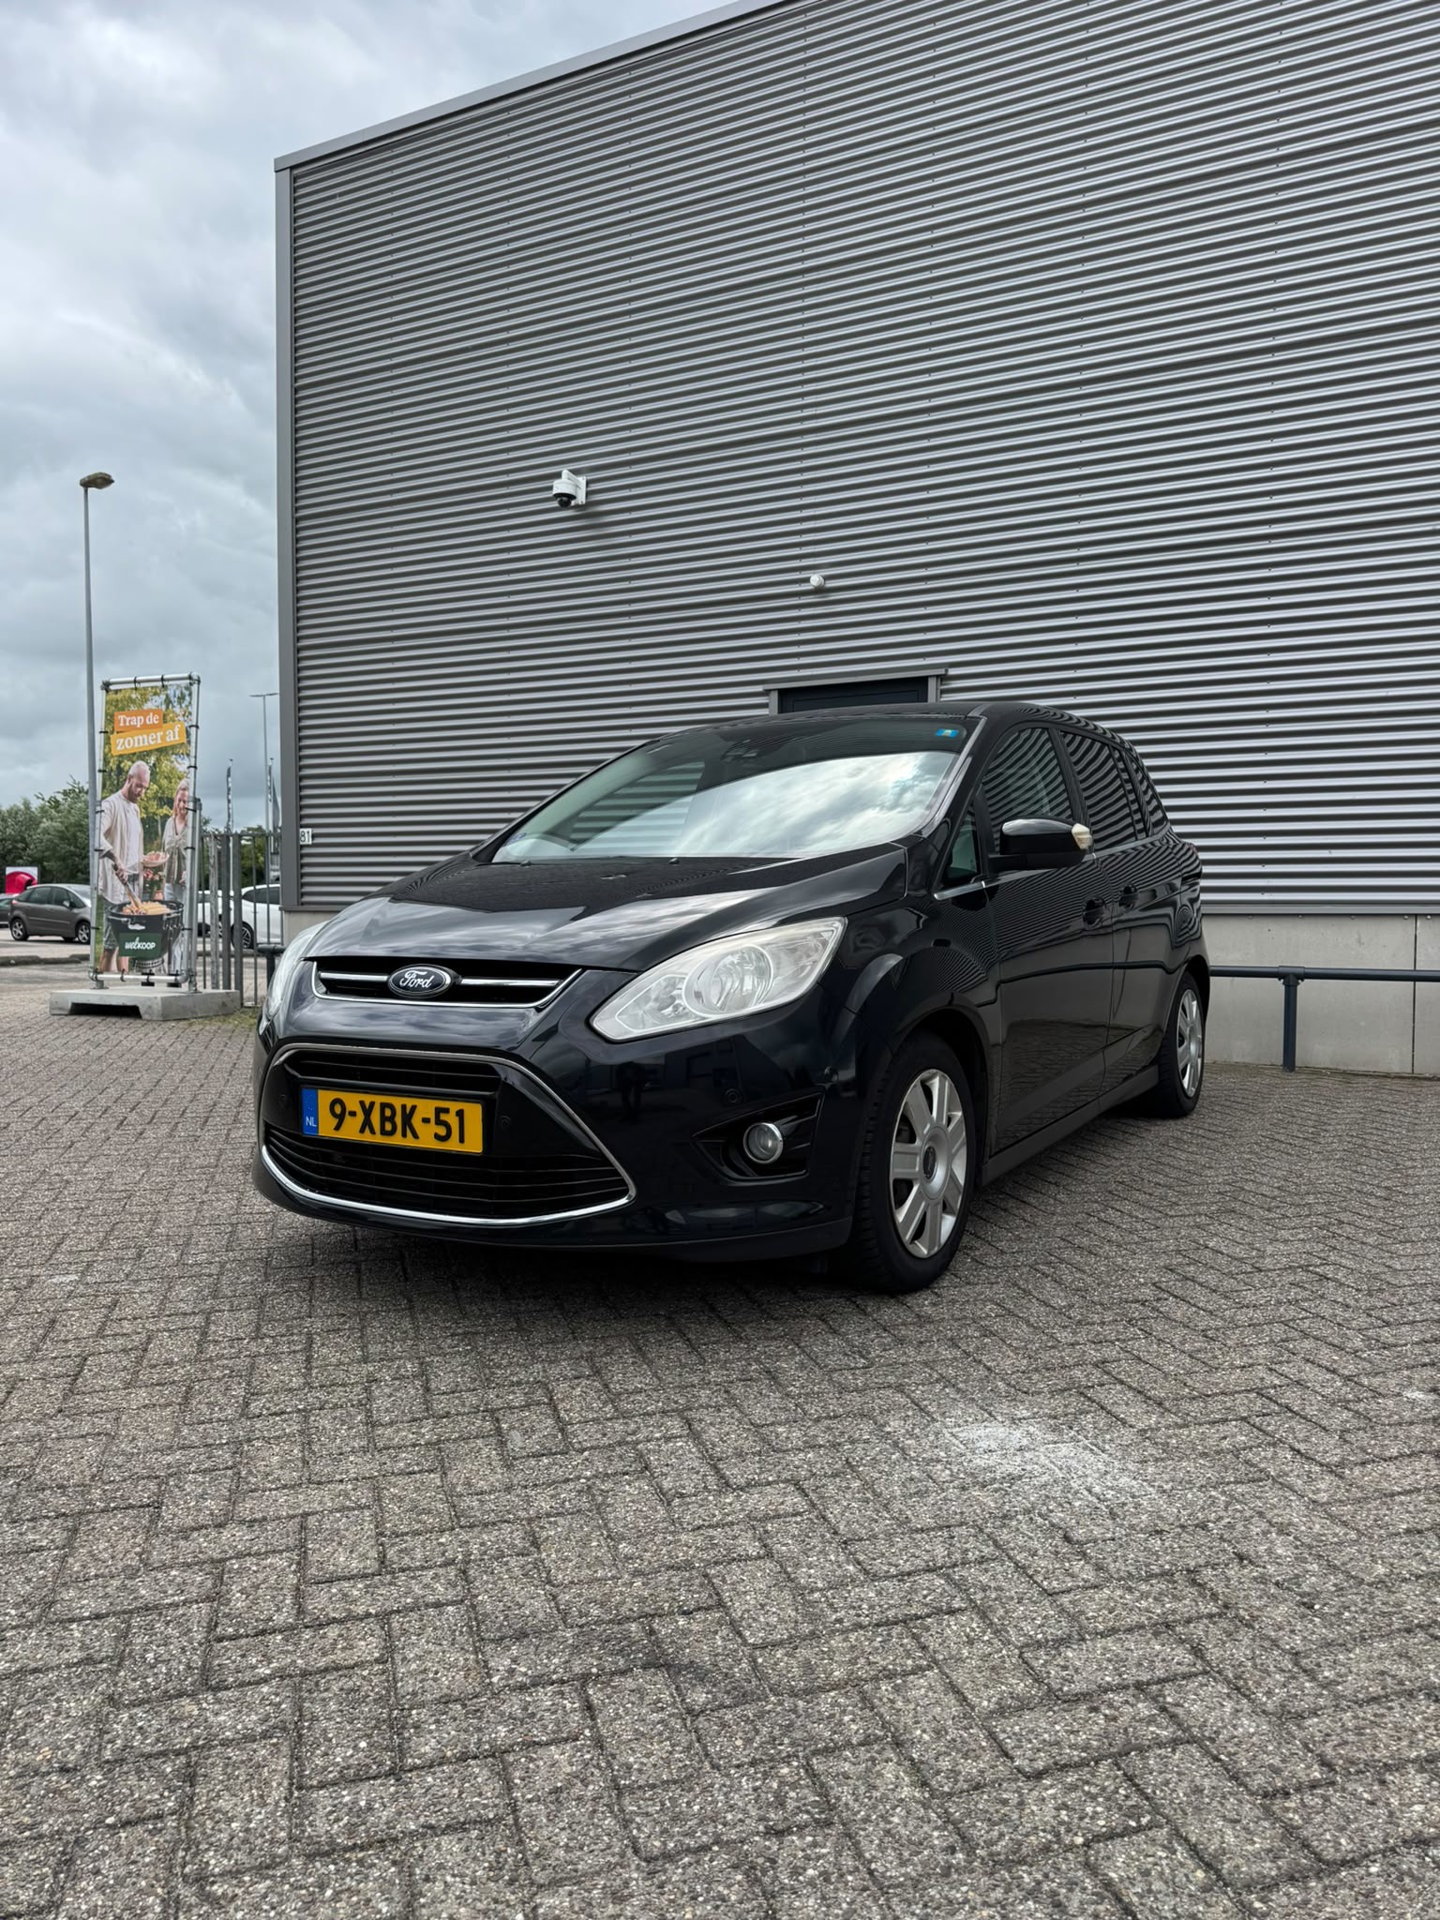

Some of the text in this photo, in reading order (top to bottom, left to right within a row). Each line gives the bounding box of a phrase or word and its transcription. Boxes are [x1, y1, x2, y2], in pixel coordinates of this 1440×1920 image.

[118, 712, 159, 728] Trap de
[116, 724, 181, 751] zomer af
[300, 830, 310, 843] 81
[399, 969, 435, 988] Ford
[305, 1115, 317, 1127] NL
[329, 1097, 465, 1144] 9-XBK-51
